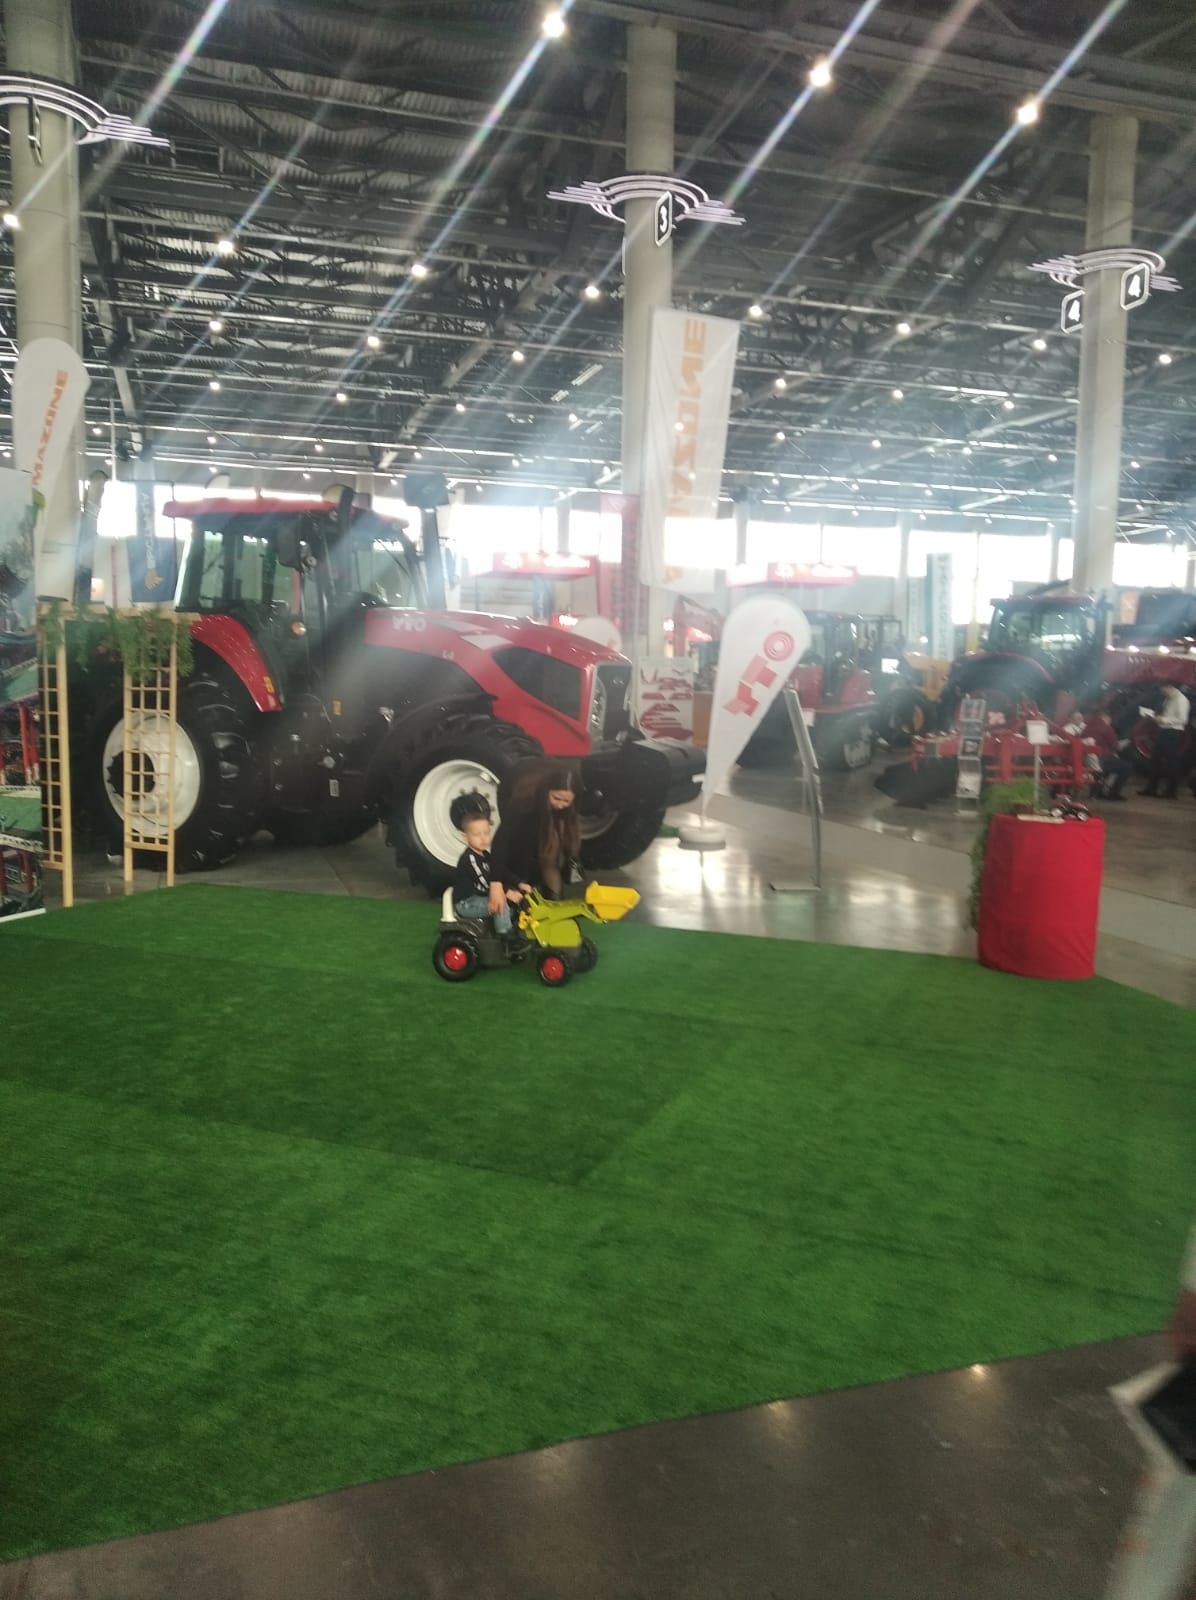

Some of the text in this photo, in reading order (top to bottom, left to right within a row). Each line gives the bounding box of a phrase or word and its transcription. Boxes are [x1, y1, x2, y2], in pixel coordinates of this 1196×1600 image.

[659, 204, 668, 233] 3
[1127, 274, 1142, 298] 4
[1067, 299, 1081, 322] 4
[31, 368, 69, 487] MAZONE
[722, 629, 796, 718] YTO
